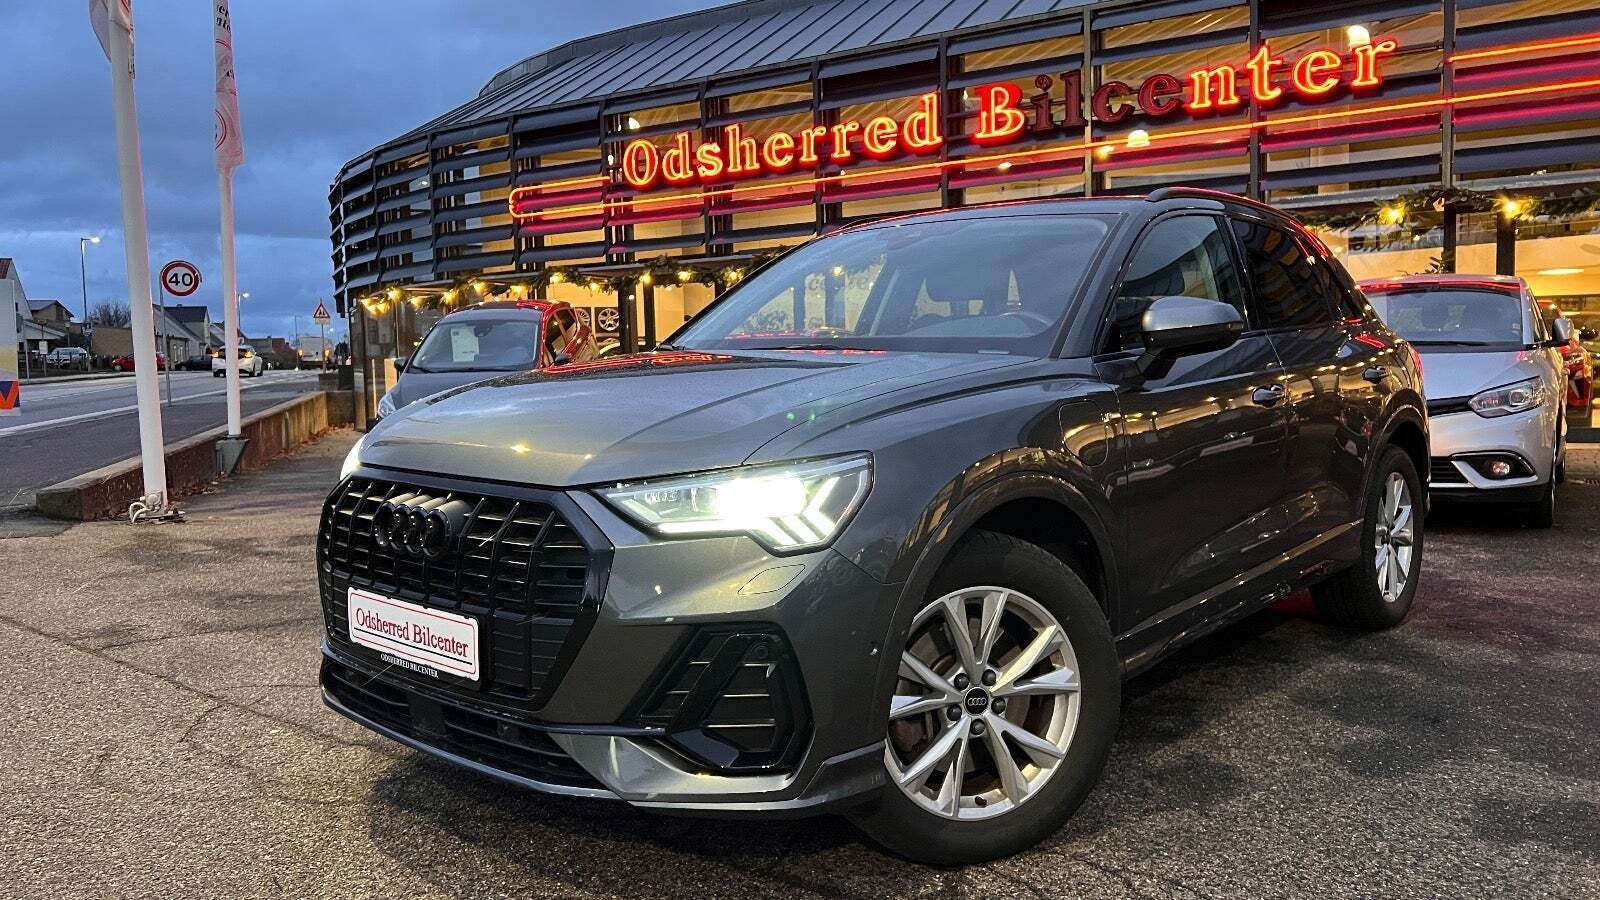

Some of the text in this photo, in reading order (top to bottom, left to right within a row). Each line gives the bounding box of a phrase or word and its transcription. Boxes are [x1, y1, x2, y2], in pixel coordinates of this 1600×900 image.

[622, 37, 1398, 188] Odsherred Bilcenter
[168, 273, 194, 287] 40
[355, 607, 469, 658] Odsherred Bilcenter
